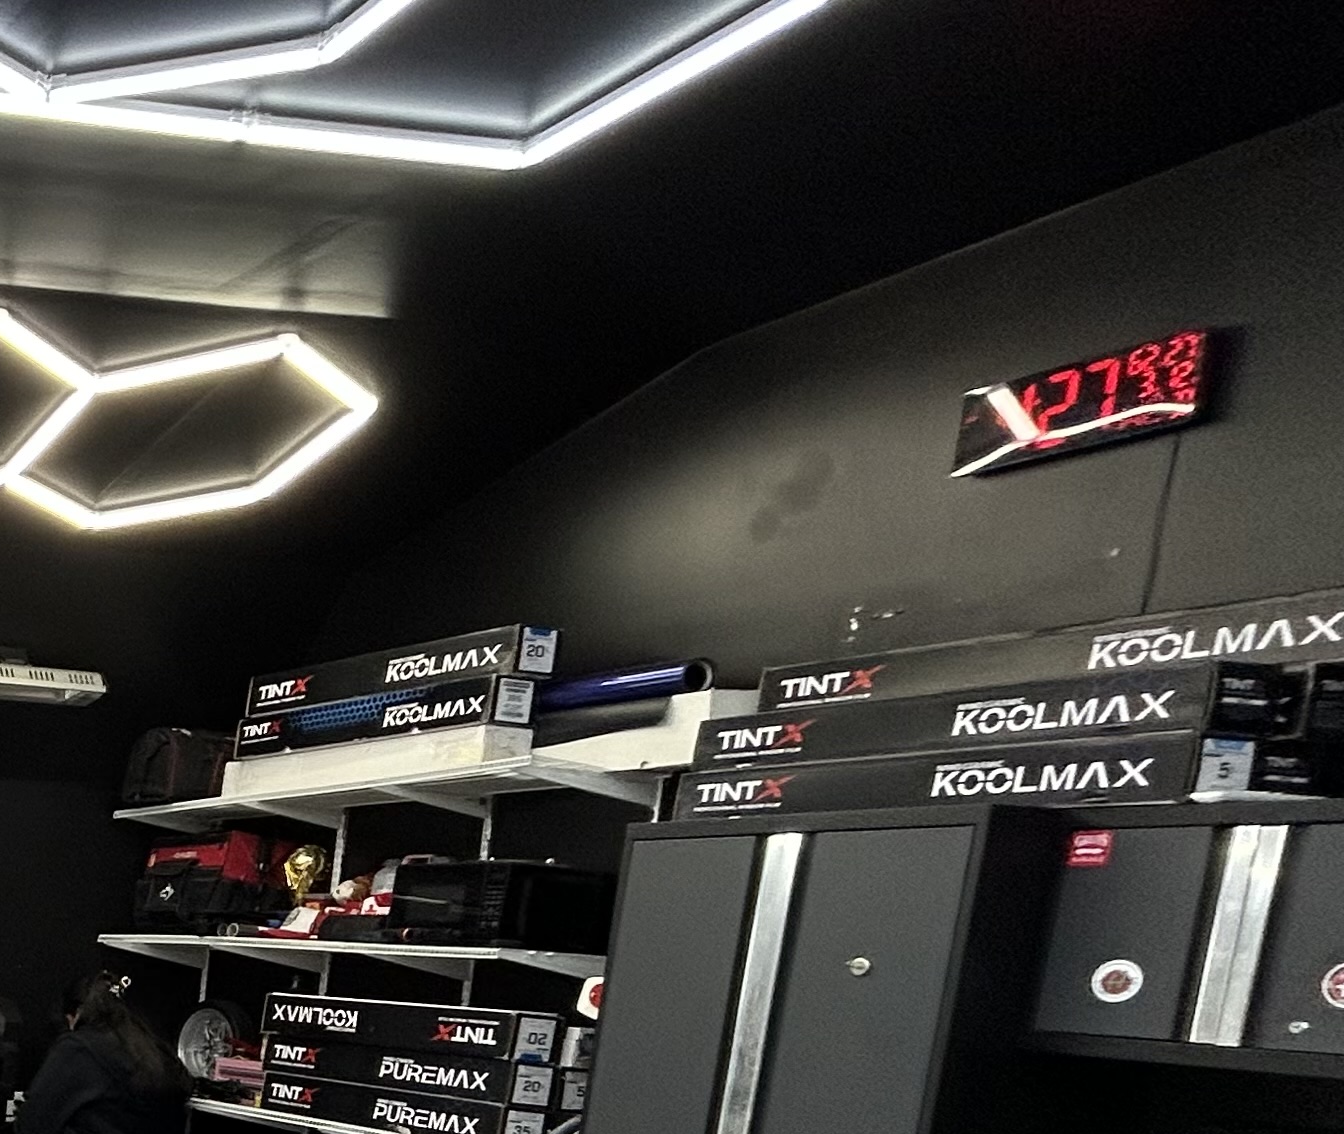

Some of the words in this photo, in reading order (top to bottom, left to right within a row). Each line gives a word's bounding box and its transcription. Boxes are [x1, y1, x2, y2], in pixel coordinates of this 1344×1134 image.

[1088, 611, 1344, 670] KOOLMAX
[384, 643, 503, 684] KOOLMAX
[381, 694, 485, 728] KOOLMAX
[950, 689, 1176, 736] KOOLMAX
[929, 757, 1155, 797] KOOLMAX
[272, 1003, 359, 1029] KOOLMAX
[378, 1060, 490, 1092] PUREMAX
